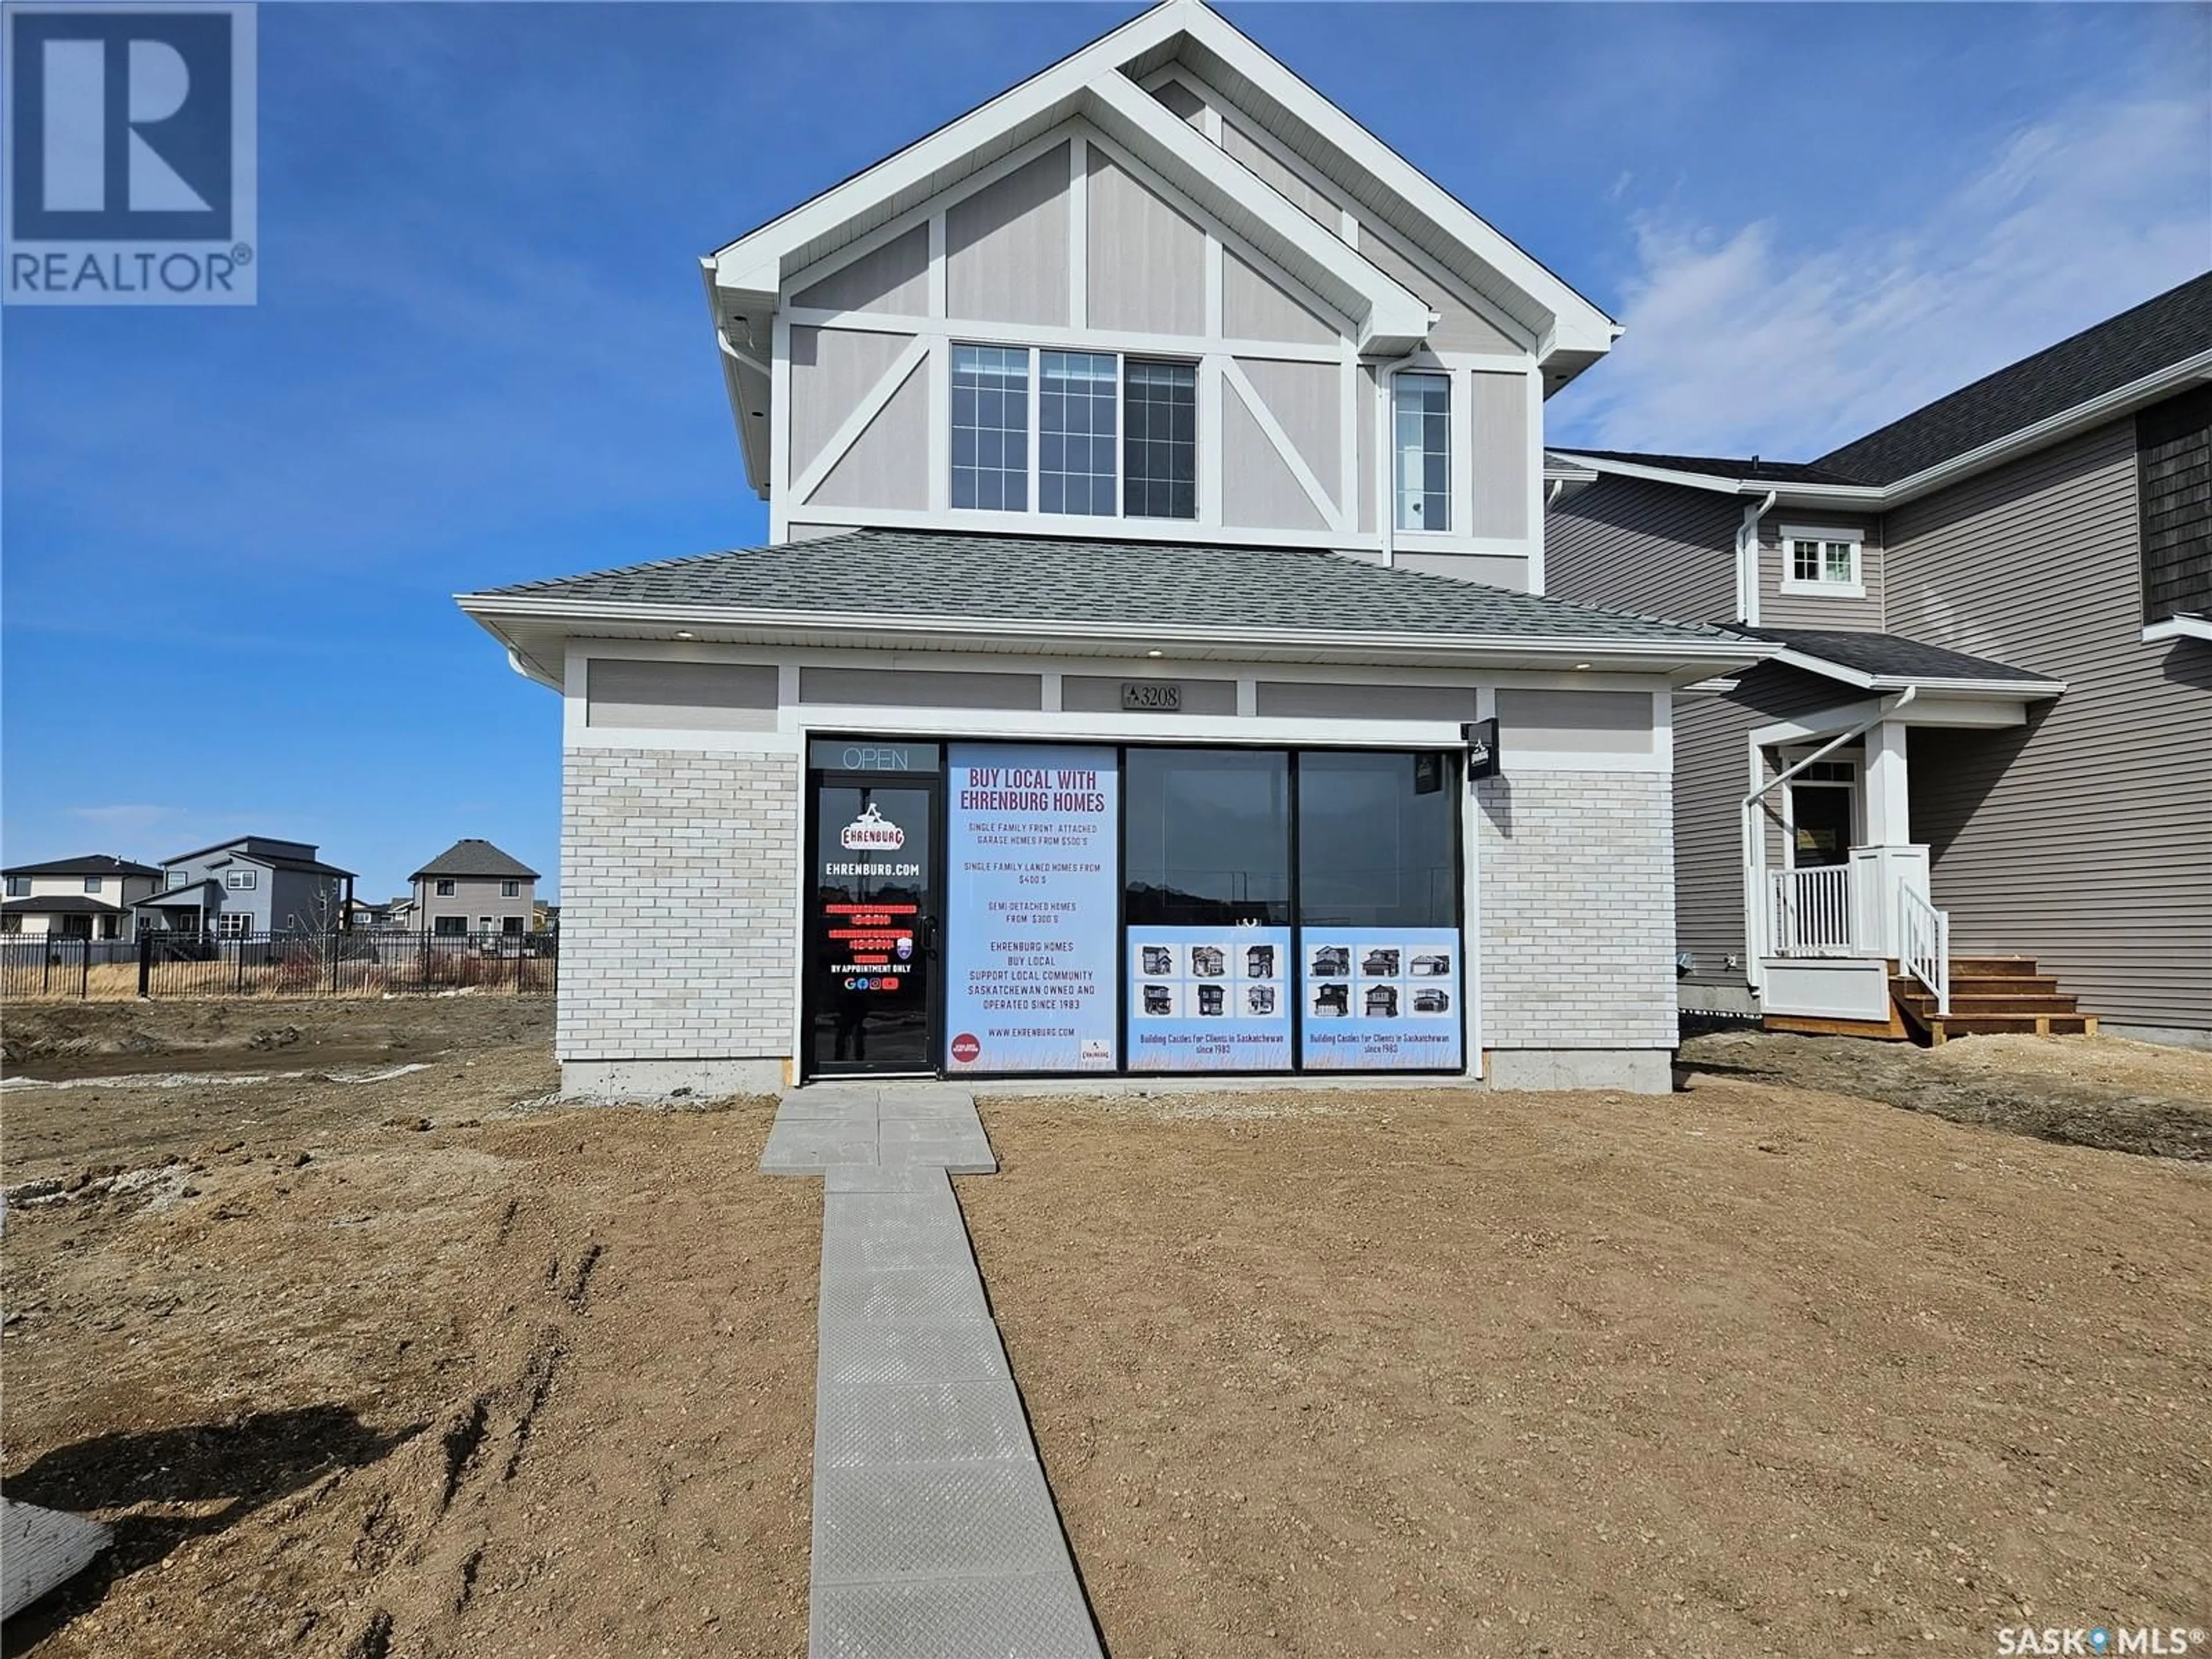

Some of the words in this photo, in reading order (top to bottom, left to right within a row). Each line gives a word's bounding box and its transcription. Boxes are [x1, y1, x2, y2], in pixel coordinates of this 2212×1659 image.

[1141, 687, 1177, 706] 3208
[843, 747, 908, 770] OPEN
[970, 768, 999, 787] BUY
[1005, 769, 1052, 789] LOCAL
[1058, 770, 1096, 790] WITH
[961, 790, 1048, 811] EHRENBURG
[1054, 793, 1105, 812] HOMES
[969, 823, 995, 832] SINGLE
[998, 823, 1026, 833] FAMILY
[1029, 824, 1053, 833] FRONT
[1058, 824, 1097, 834] ATTACHED
[843, 828, 903, 844] EHRENBURG
[978, 836, 1007, 845] GARAGE
[1010, 836, 1036, 845] HOMES
[1038, 836, 1059, 845] FROM
[826, 863, 919, 876] EHRENBURG.COM
[964, 862, 990, 871] SINGLE
[994, 862, 1021, 872] FAMILY
[1025, 863, 1050, 872] LANED
[1052, 863, 1077, 872] HOMES
[1080, 863, 1100, 872] FROM
[1018, 874, 1046, 884] $400S
[988, 902, 1048, 911] SEMI-DETACHED
[1051, 902, 1076, 911] HOMES
[1006, 915, 1027, 923] FROM
[991, 942, 1041, 952] EHRENBURG
[1044, 942, 1074, 952] HOMES
[1007, 956, 1024, 966] BUY
[1028, 956, 1055, 966] LOCAL
[831, 965, 840, 973] BY
[842, 965, 891, 973] APPOINTMENT
[893, 965, 911, 973] ONLY
[969, 971, 1007, 980] SUPPORT
[1012, 971, 1039, 980] LOCAL
[1043, 971, 1093, 980] COMMUNITY
[968, 985, 1040, 995] SASKATCHEWAN
[1044, 985, 1074, 995] OWNED
[1077, 985, 1094, 995] AND
[983, 999, 1028, 1009] OPERATED
[1032, 999, 1055, 1009] SINCE
[1060, 999, 1080, 1009] 1983
[1141, 1034, 1166, 1046] Building
[1168, 1034, 1191, 1043] Castles
[1193, 1034, 1204, 1043] for
[1206, 1034, 1228, 1043] Clients
[1236, 1034, 1283, 1043] Saskatchewan
[1310, 1034, 1335, 1045] Building
[1337, 1034, 1359, 1043] Castles
[1362, 1034, 1372, 1043] for
[1403, 1033, 1449, 1043] Saskatchewan
[1196, 1045, 1213, 1054] since
[1364, 1044, 1381, 1053] since
